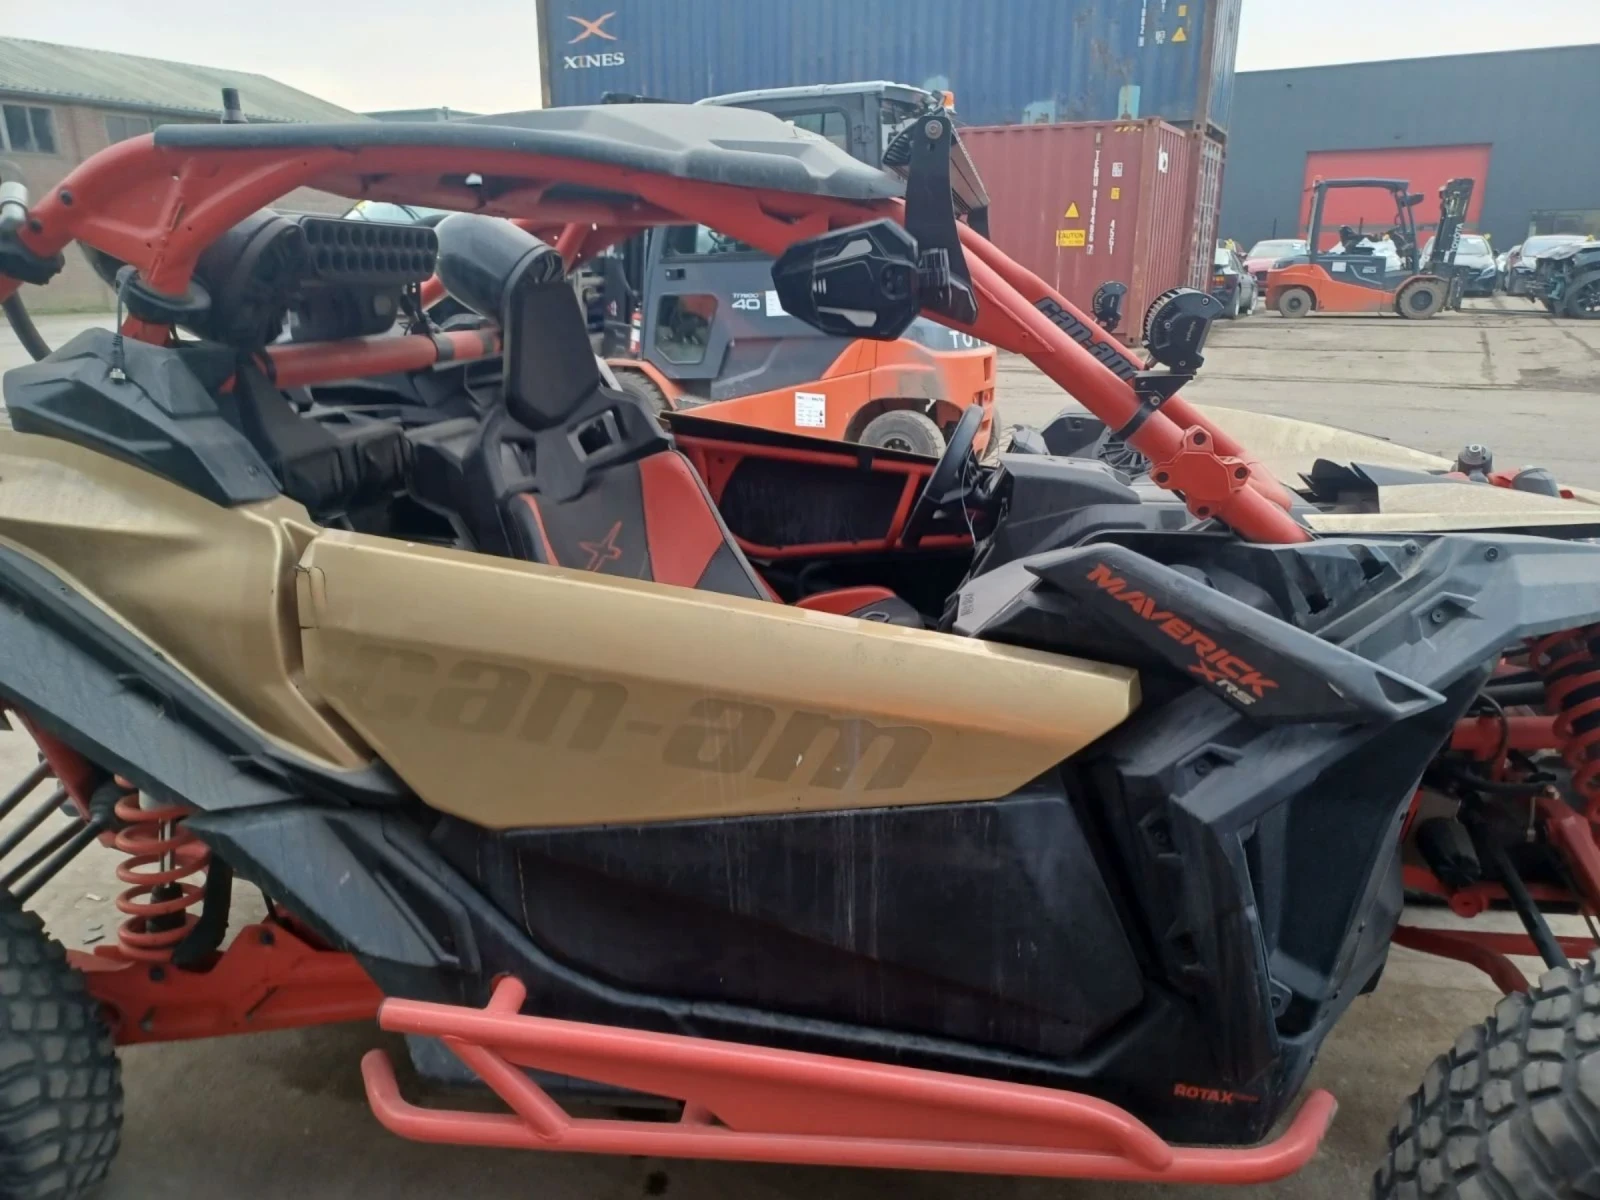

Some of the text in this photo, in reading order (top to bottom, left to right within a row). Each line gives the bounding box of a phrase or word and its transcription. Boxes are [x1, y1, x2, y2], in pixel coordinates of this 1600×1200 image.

[564, 52, 625, 69] XINES
[1450, 222, 1464, 252] TOYOTA
[731, 299, 761, 310] 40
[1034, 297, 1139, 381] can-am
[1086, 562, 1279, 698] MAVERICK
[345, 642, 933, 790] can-am
[1173, 1082, 1234, 1104] ROTAX
